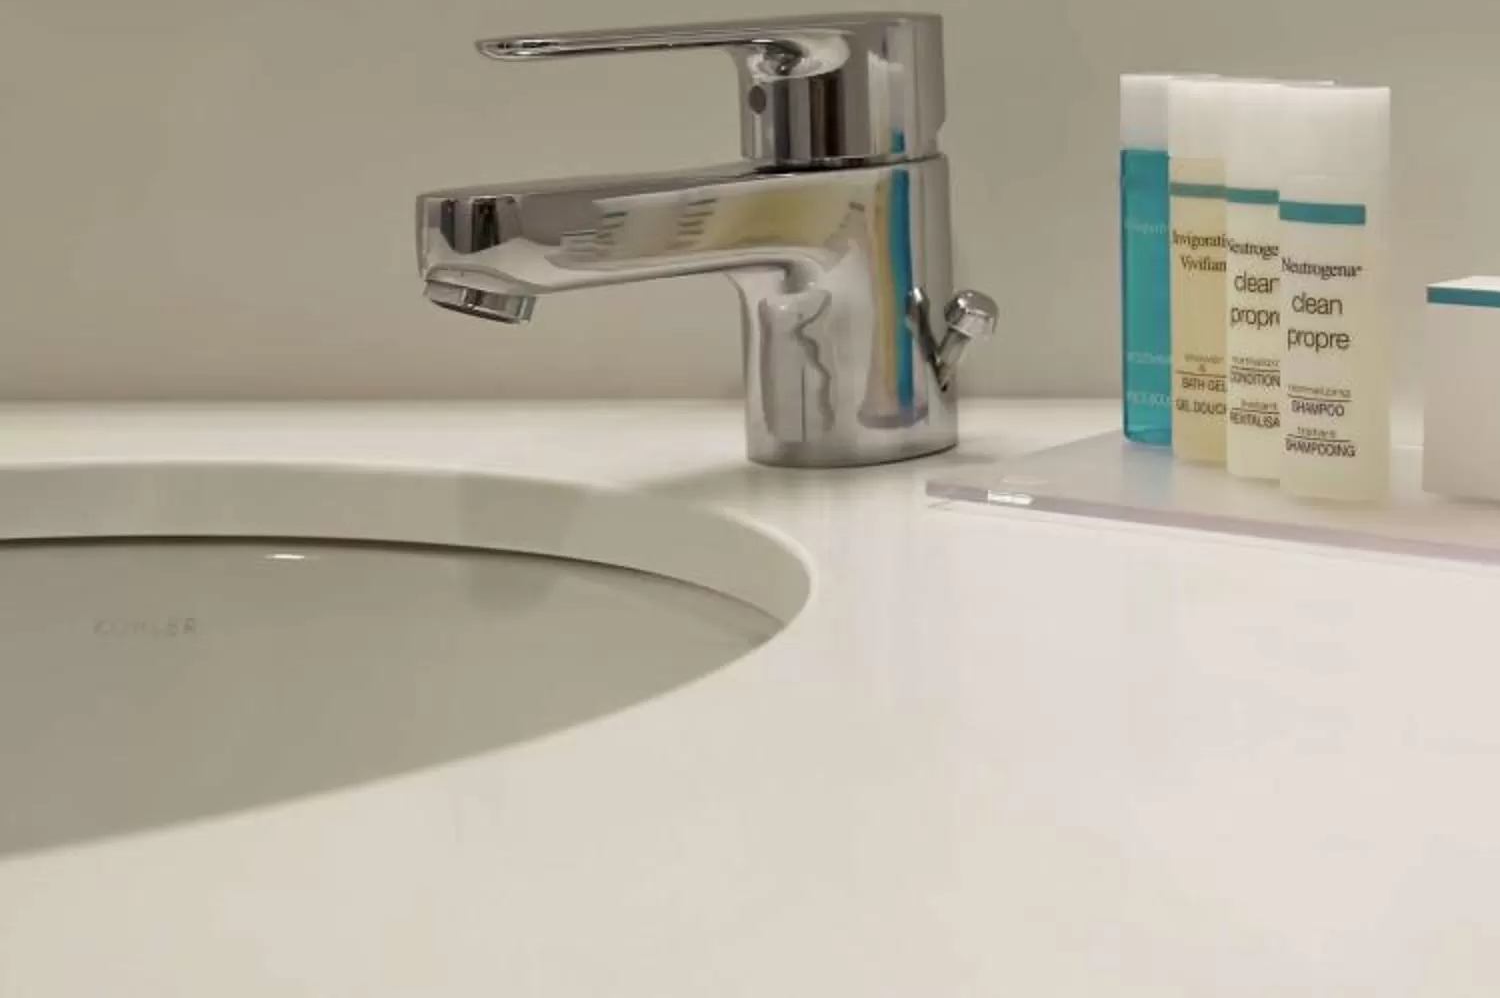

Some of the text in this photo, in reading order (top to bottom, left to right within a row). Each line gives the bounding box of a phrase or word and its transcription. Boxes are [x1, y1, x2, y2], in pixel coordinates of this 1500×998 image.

[1291, 290, 1343, 315] clean
[1230, 306, 1280, 331] propr
[1287, 328, 1350, 354] propre
